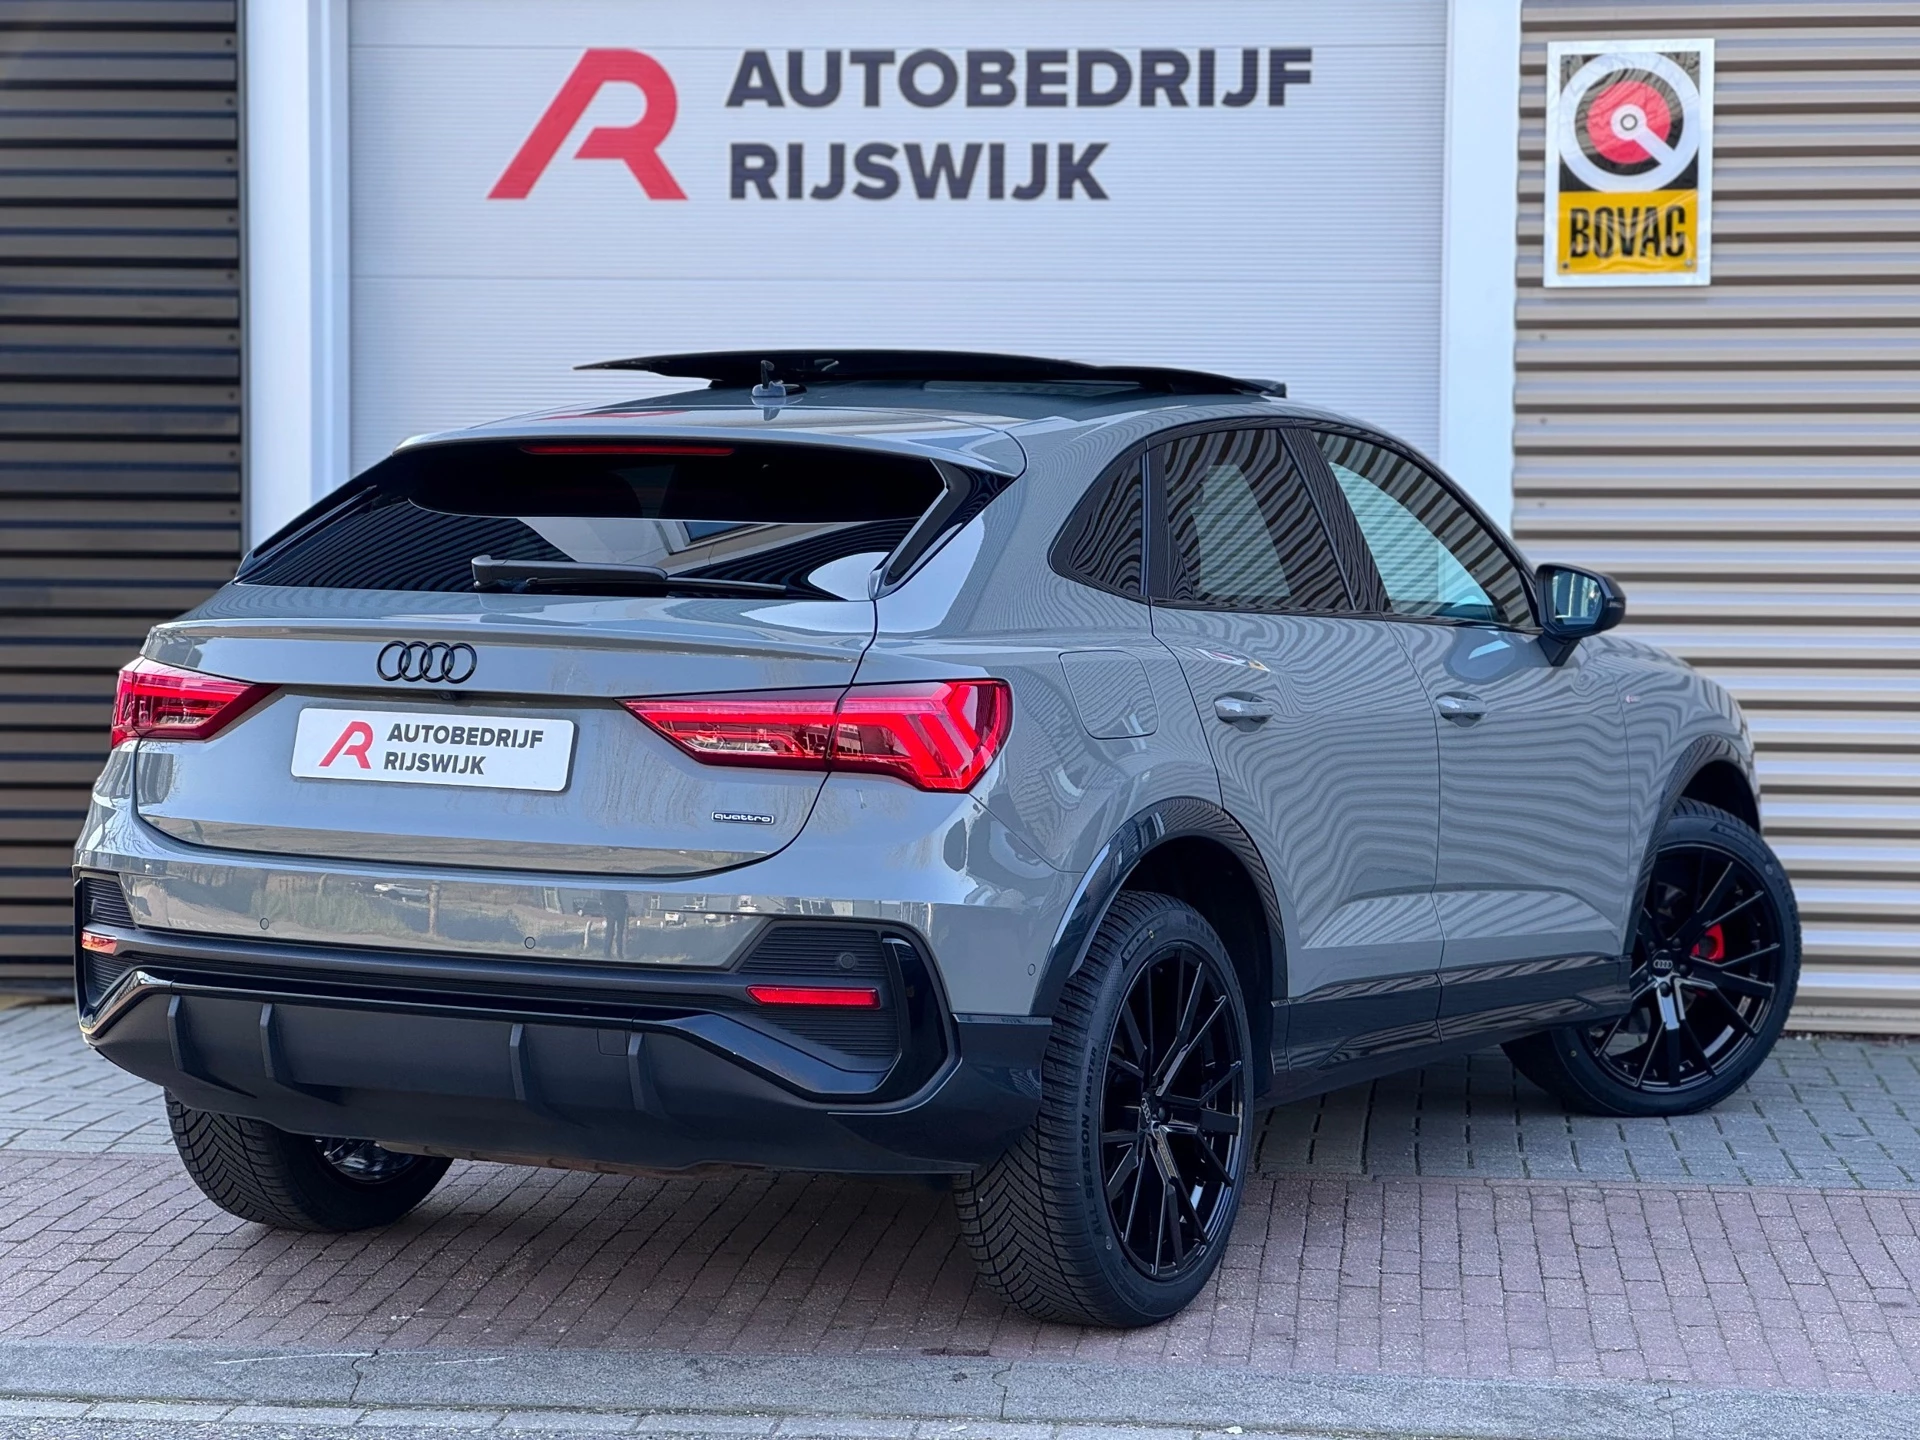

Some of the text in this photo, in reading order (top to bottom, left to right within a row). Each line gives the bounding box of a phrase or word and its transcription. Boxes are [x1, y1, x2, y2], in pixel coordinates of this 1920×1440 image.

[726, 48, 1313, 109] AUTOBEDRIJF
[730, 142, 1110, 201] RIJSWIJK
[1569, 204, 1687, 259] BOVAG
[383, 751, 487, 776] RIJSWIJK
[387, 723, 544, 749] AUTOBEDRIJF
[714, 813, 771, 822] quattro
[1084, 1046, 1098, 1108] MASTER
[1081, 1113, 1095, 1199] SEASON
